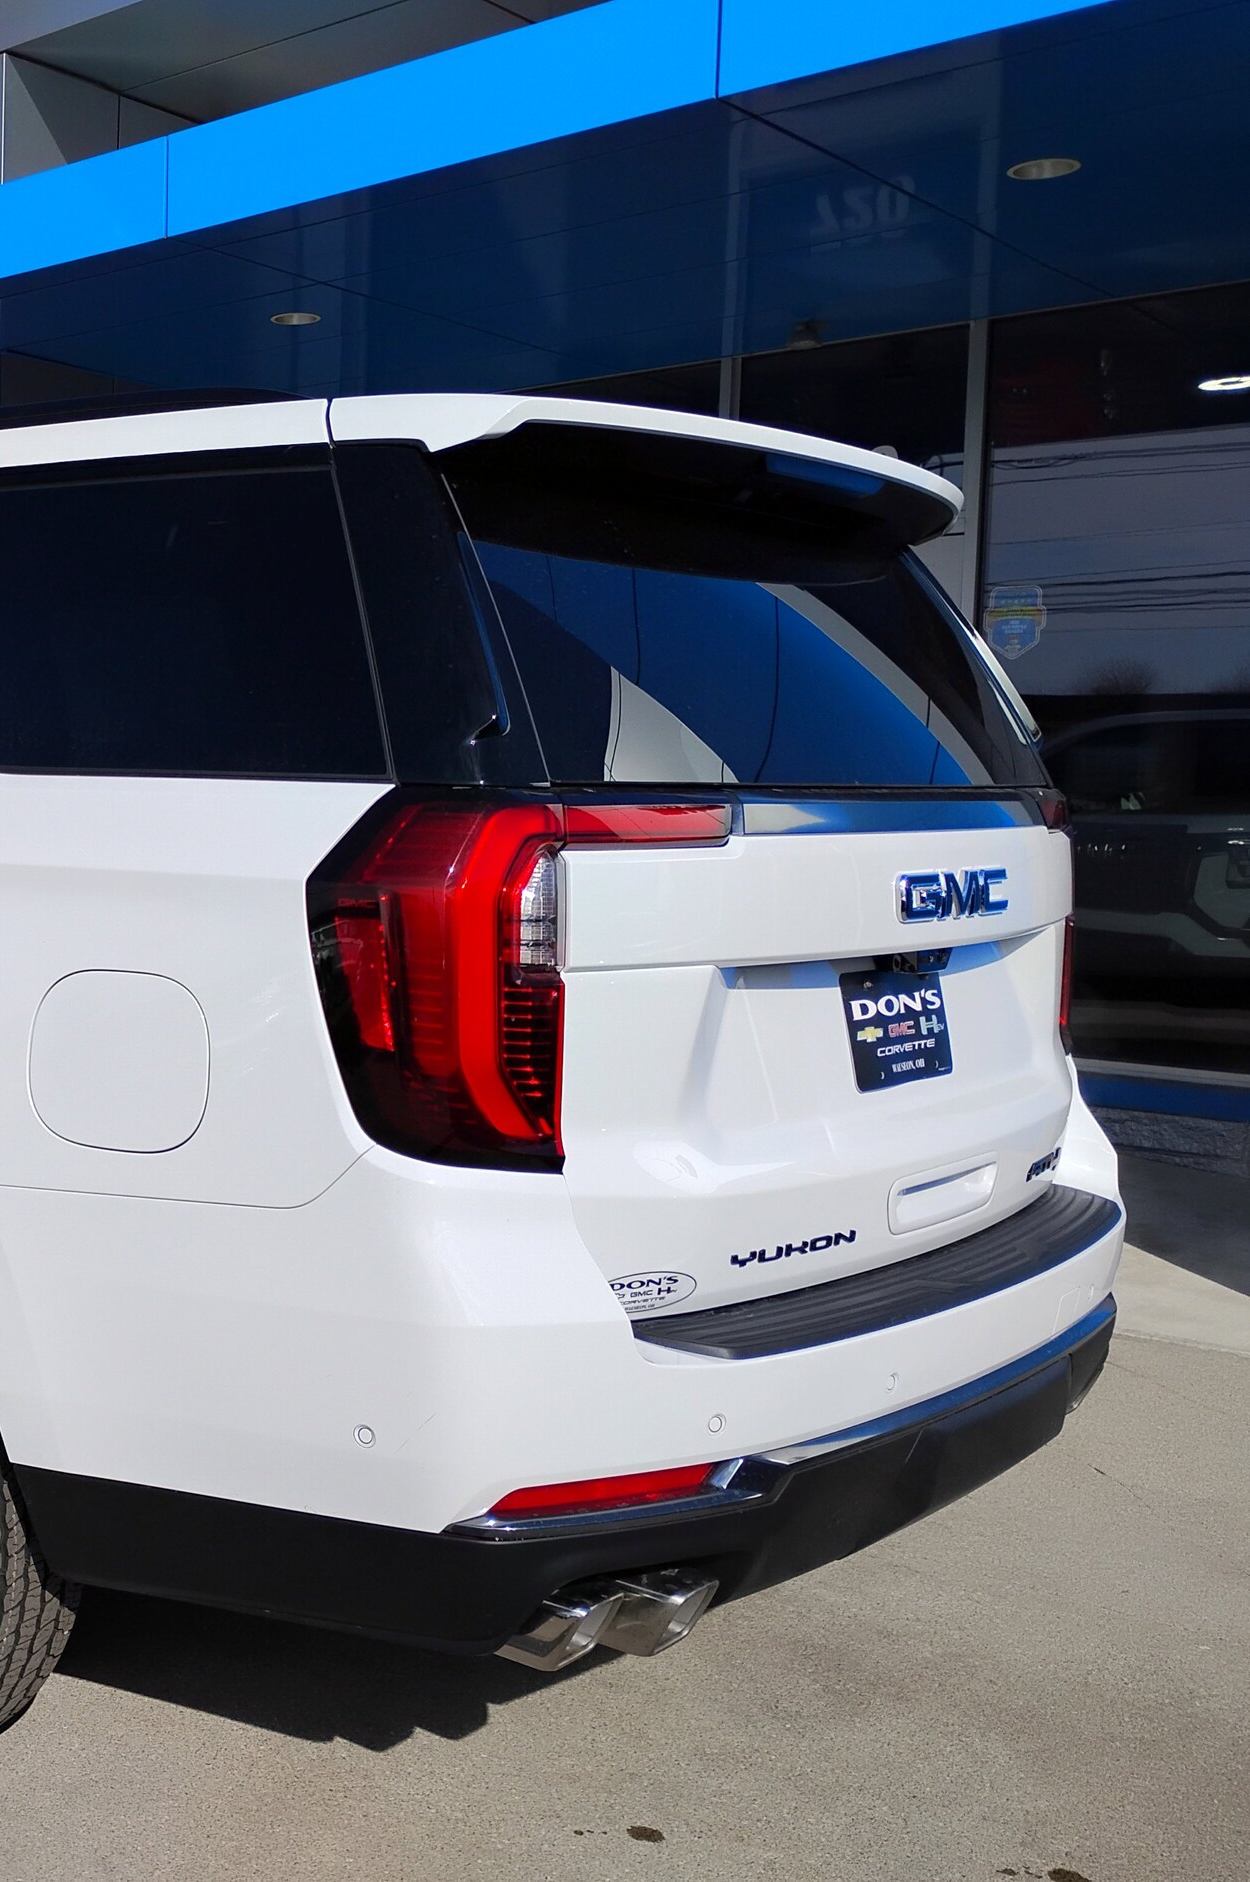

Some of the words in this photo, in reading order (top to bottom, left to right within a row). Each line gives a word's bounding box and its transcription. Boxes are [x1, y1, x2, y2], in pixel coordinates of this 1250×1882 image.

[337, 898, 377, 909] GMC
[894, 868, 1009, 922] GMC
[849, 988, 941, 1021] DON'S
[887, 1020, 916, 1038] GMC
[876, 1038, 936, 1057] CORVETTE
[730, 1229, 857, 1267] YUKON
[609, 1275, 679, 1291] DON'S
[630, 1289, 654, 1298] GMC
